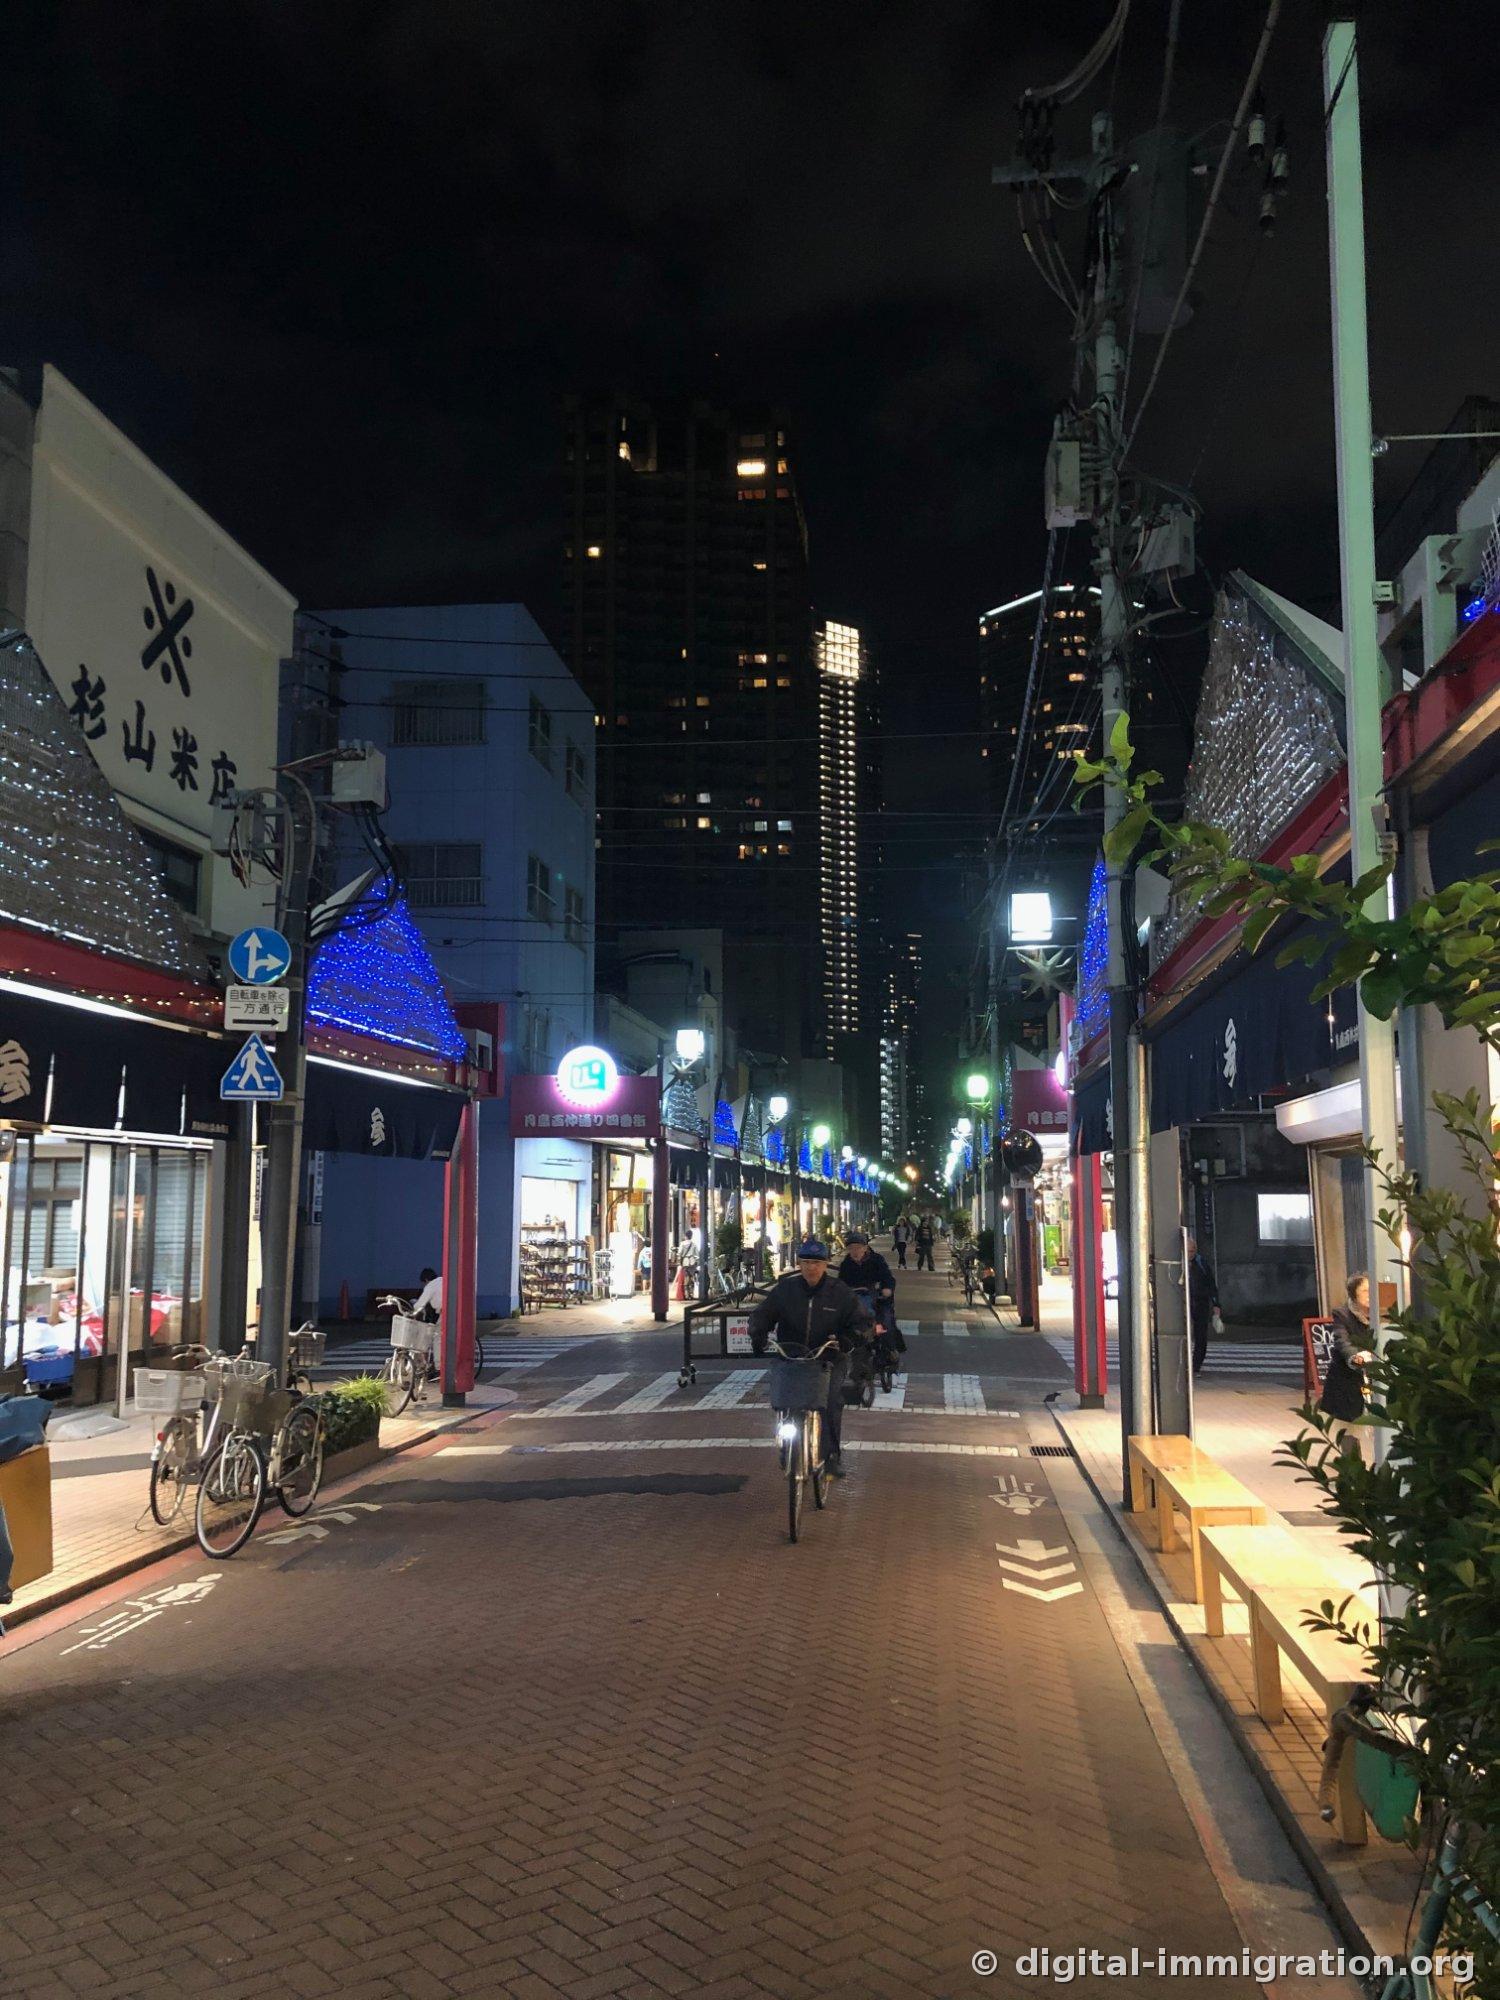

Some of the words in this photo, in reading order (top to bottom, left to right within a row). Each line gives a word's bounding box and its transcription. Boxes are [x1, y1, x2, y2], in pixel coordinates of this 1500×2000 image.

[230, 989, 285, 1002] 自転車を除く
[229, 1003, 285, 1015] 一方通行
